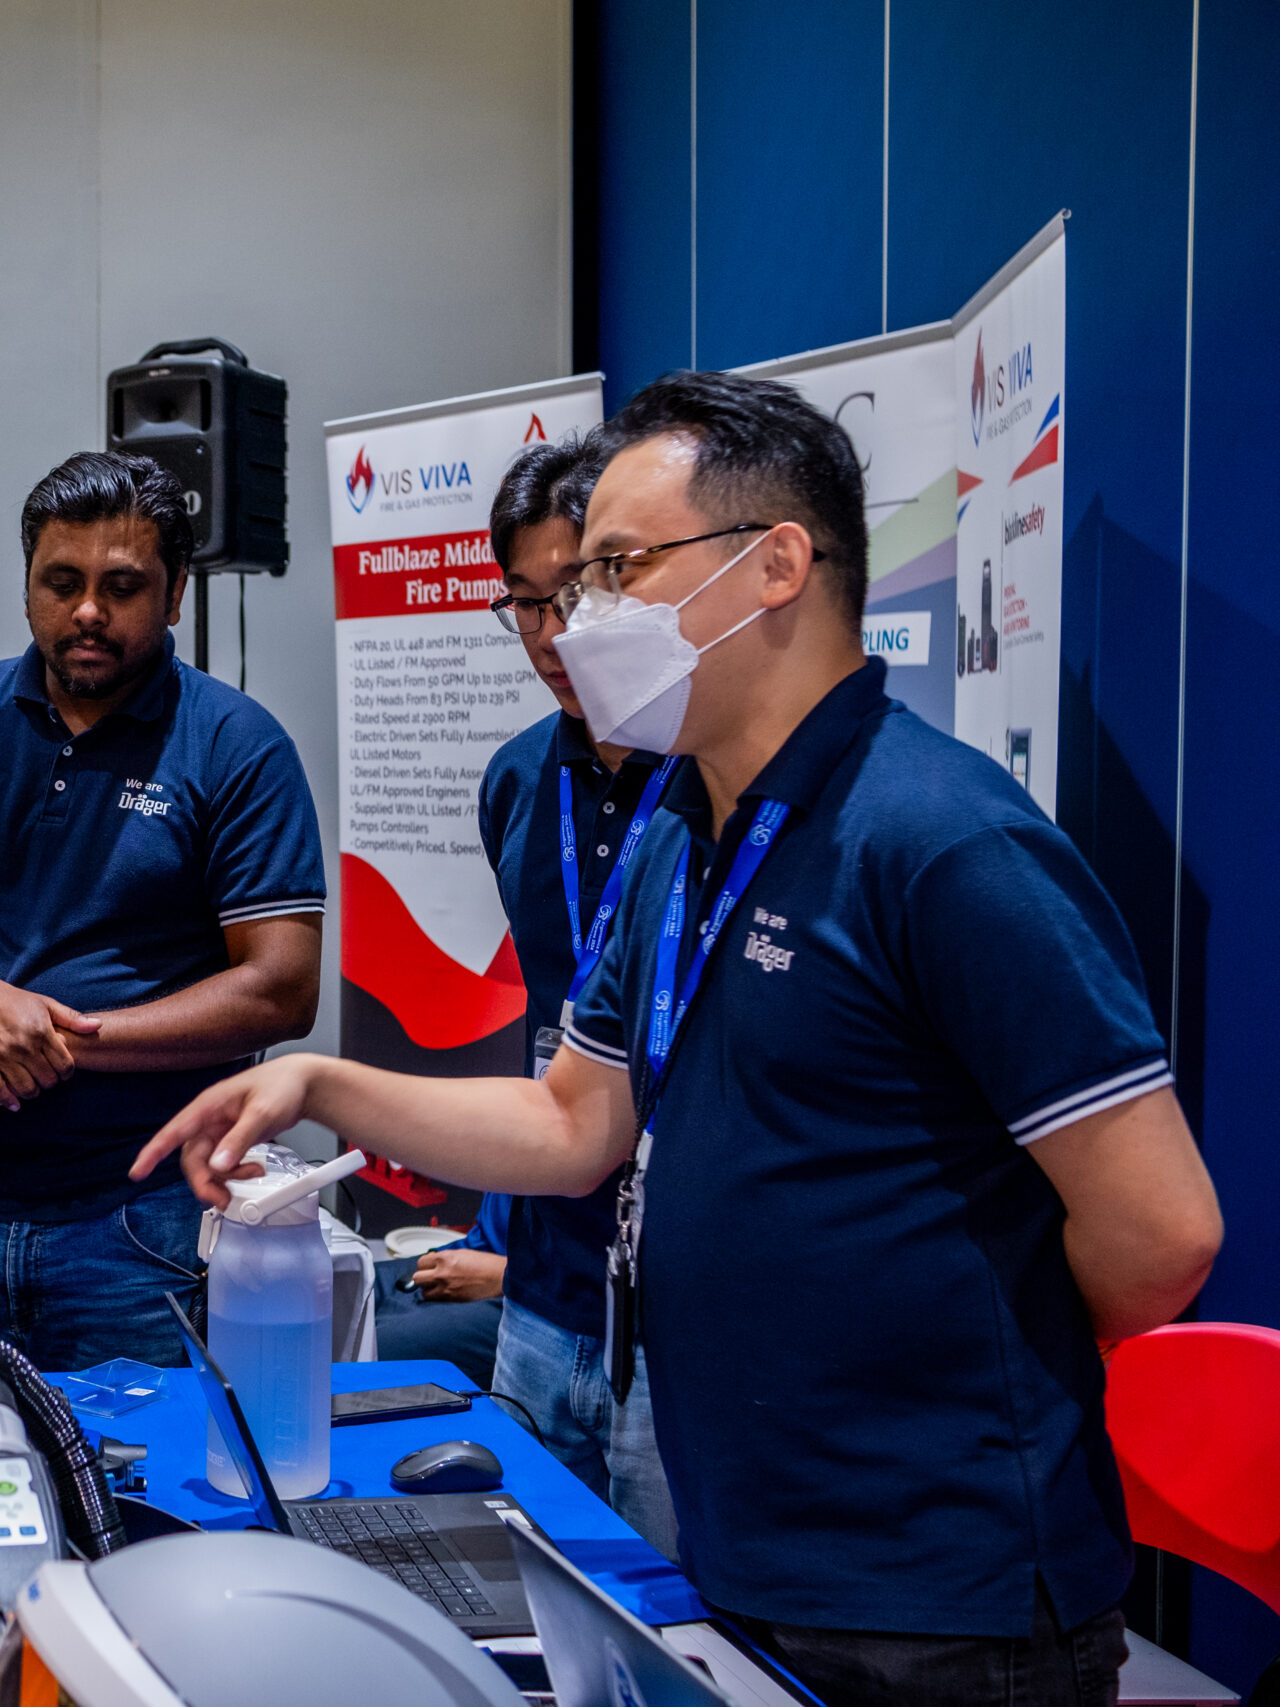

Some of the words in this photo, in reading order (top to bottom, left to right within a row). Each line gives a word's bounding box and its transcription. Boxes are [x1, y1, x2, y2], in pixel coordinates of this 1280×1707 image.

[380, 469, 412, 496] VIS
[419, 461, 472, 491] VIVA
[422, 492, 472, 507] PROTECTION
[358, 545, 441, 575] Fullblaze
[406, 578, 442, 605] Fire
[446, 576, 511, 603] Pumps
[354, 639, 377, 652] NFPA
[394, 638, 406, 651] UL
[409, 637, 424, 650] 448
[426, 637, 444, 649] and
[446, 635, 461, 648] FM
[354, 658, 366, 671] UL
[367, 657, 396, 671] Listed
[397, 657, 403, 669] /
[405, 656, 419, 669] FM
[421, 654, 466, 672] Approved
[354, 676, 374, 692] Duty
[376, 676, 402, 688] Flows
[404, 674, 426, 688] From
[427, 676, 440, 689] 50
[441, 673, 464, 686] GPM
[467, 673, 480, 688] Up
[482, 673, 492, 685] to
[493, 673, 513, 687] 1500
[515, 670, 537, 684] GPM
[354, 694, 374, 710] Duty
[376, 694, 404, 706] Heads
[406, 693, 429, 706] From
[430, 692, 442, 707] 83
[444, 692, 460, 705] PSI
[462, 691, 476, 707] Up
[478, 692, 488, 704] to
[489, 693, 505, 706] 239
[506, 690, 520, 704] PSI
[354, 712, 380, 724] Rated
[382, 712, 410, 727] Speed
[411, 713, 420, 724] at
[422, 713, 446, 726] 2900
[448, 711, 470, 723] RPM
[354, 730, 387, 743] Electric
[389, 730, 417, 742] Driven
[419, 730, 439, 743] Sets
[440, 729, 464, 745] Fully
[350, 749, 361, 761] UL
[362, 749, 390, 761] Listed
[392, 749, 422, 761] Motors
[354, 766, 381, 779] Diesel
[382, 766, 411, 779] Driven
[413, 766, 432, 780] Sets
[434, 766, 458, 783] Fully
[125, 778, 143, 790] We
[144, 782, 164, 792] are
[382, 785, 424, 800] Approved
[118, 792, 172, 817] Dräger
[354, 802, 394, 818] Supplied
[395, 803, 417, 816] With
[418, 803, 429, 817] UL
[431, 804, 463, 818] Listed
[350, 820, 379, 835] Pumps
[380, 821, 430, 836] Controllers
[354, 838, 414, 857] Competitively
[753, 906, 770, 925] We
[769, 914, 789, 931] are
[743, 931, 796, 973] Dräger
